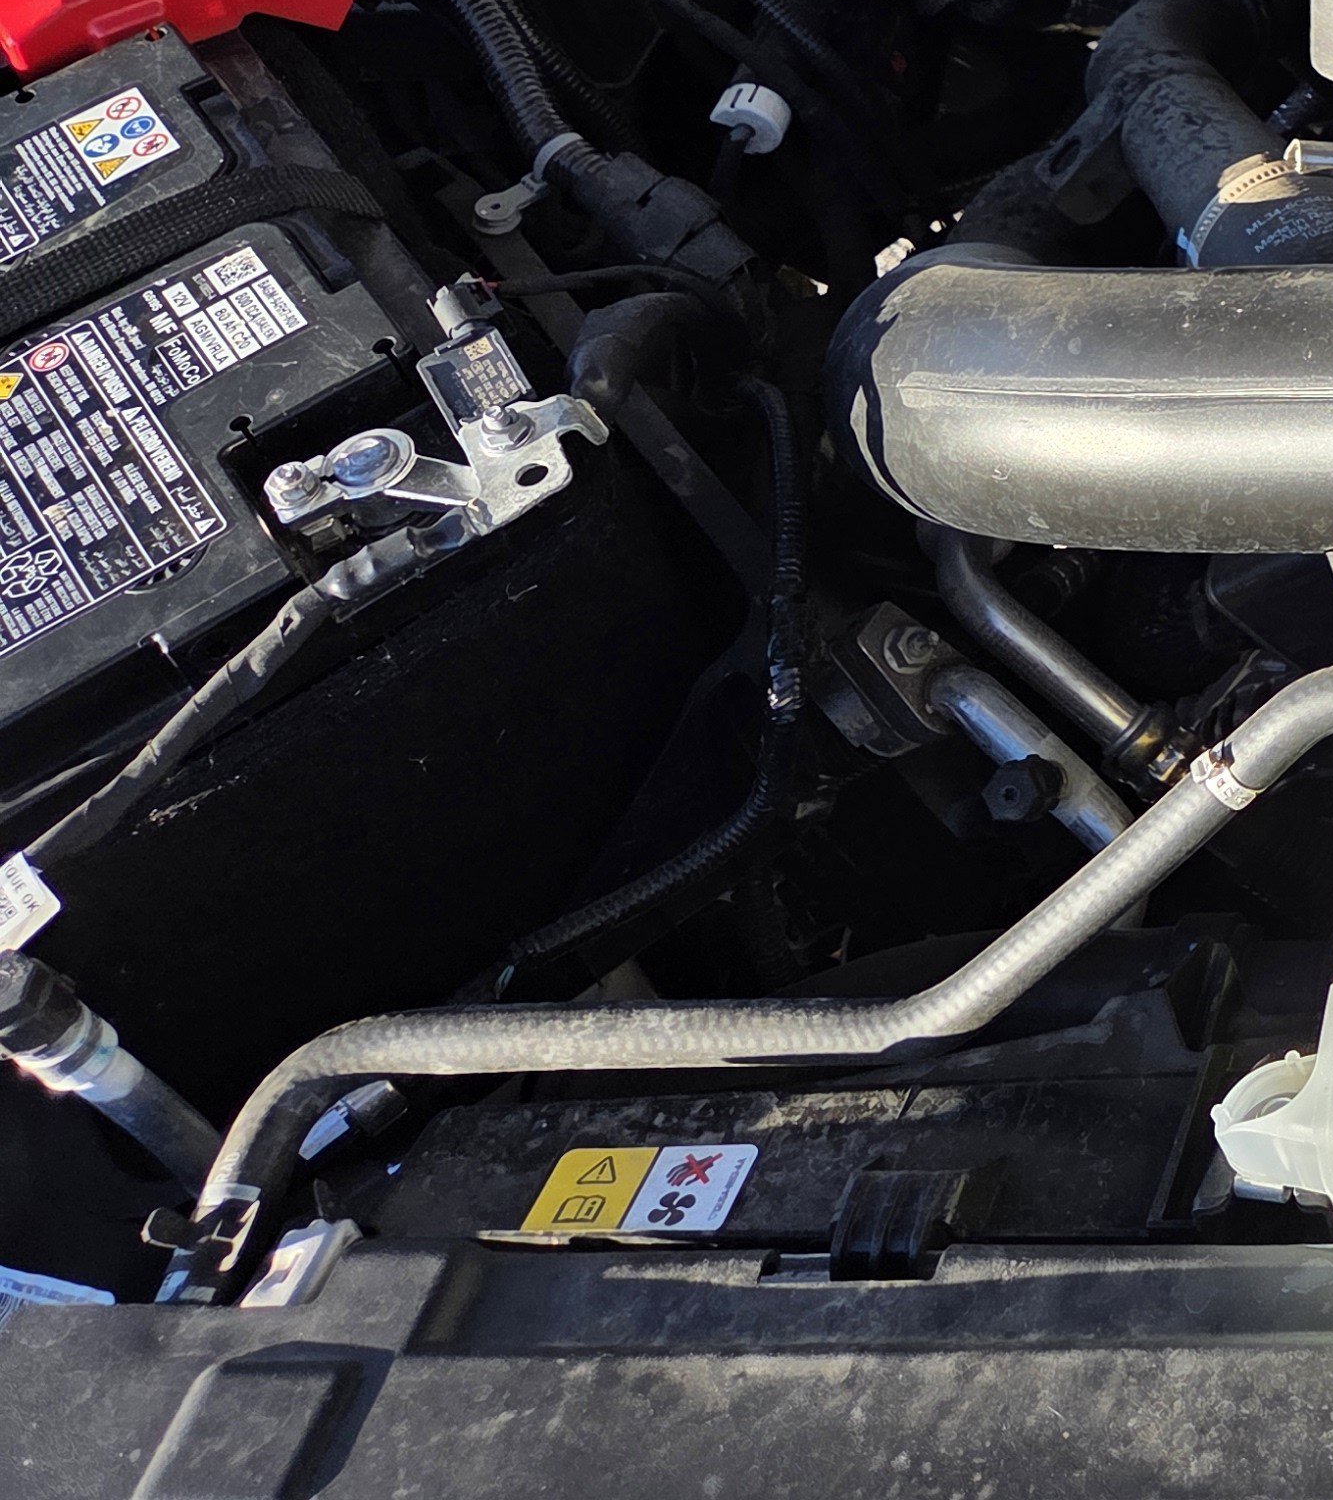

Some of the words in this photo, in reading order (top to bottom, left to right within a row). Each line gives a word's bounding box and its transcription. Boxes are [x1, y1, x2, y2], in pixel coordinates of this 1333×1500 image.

[171, 290, 191, 308] 12V
[149, 311, 178, 334] MF
[190, 317, 230, 366] AGM/VRLA
[214, 307, 231, 322] 80
[223, 318, 239, 333] Ah
[231, 330, 250, 350] C20
[78, 338, 132, 404] DANGER/POISON
[163, 338, 200, 384] FoMoCo
[130, 415, 184, 483] PELIGRO/VENENO
[4, 862, 28, 894] QUE
[22, 893, 40, 914] OK
[214, 1151, 241, 1183] RAD
